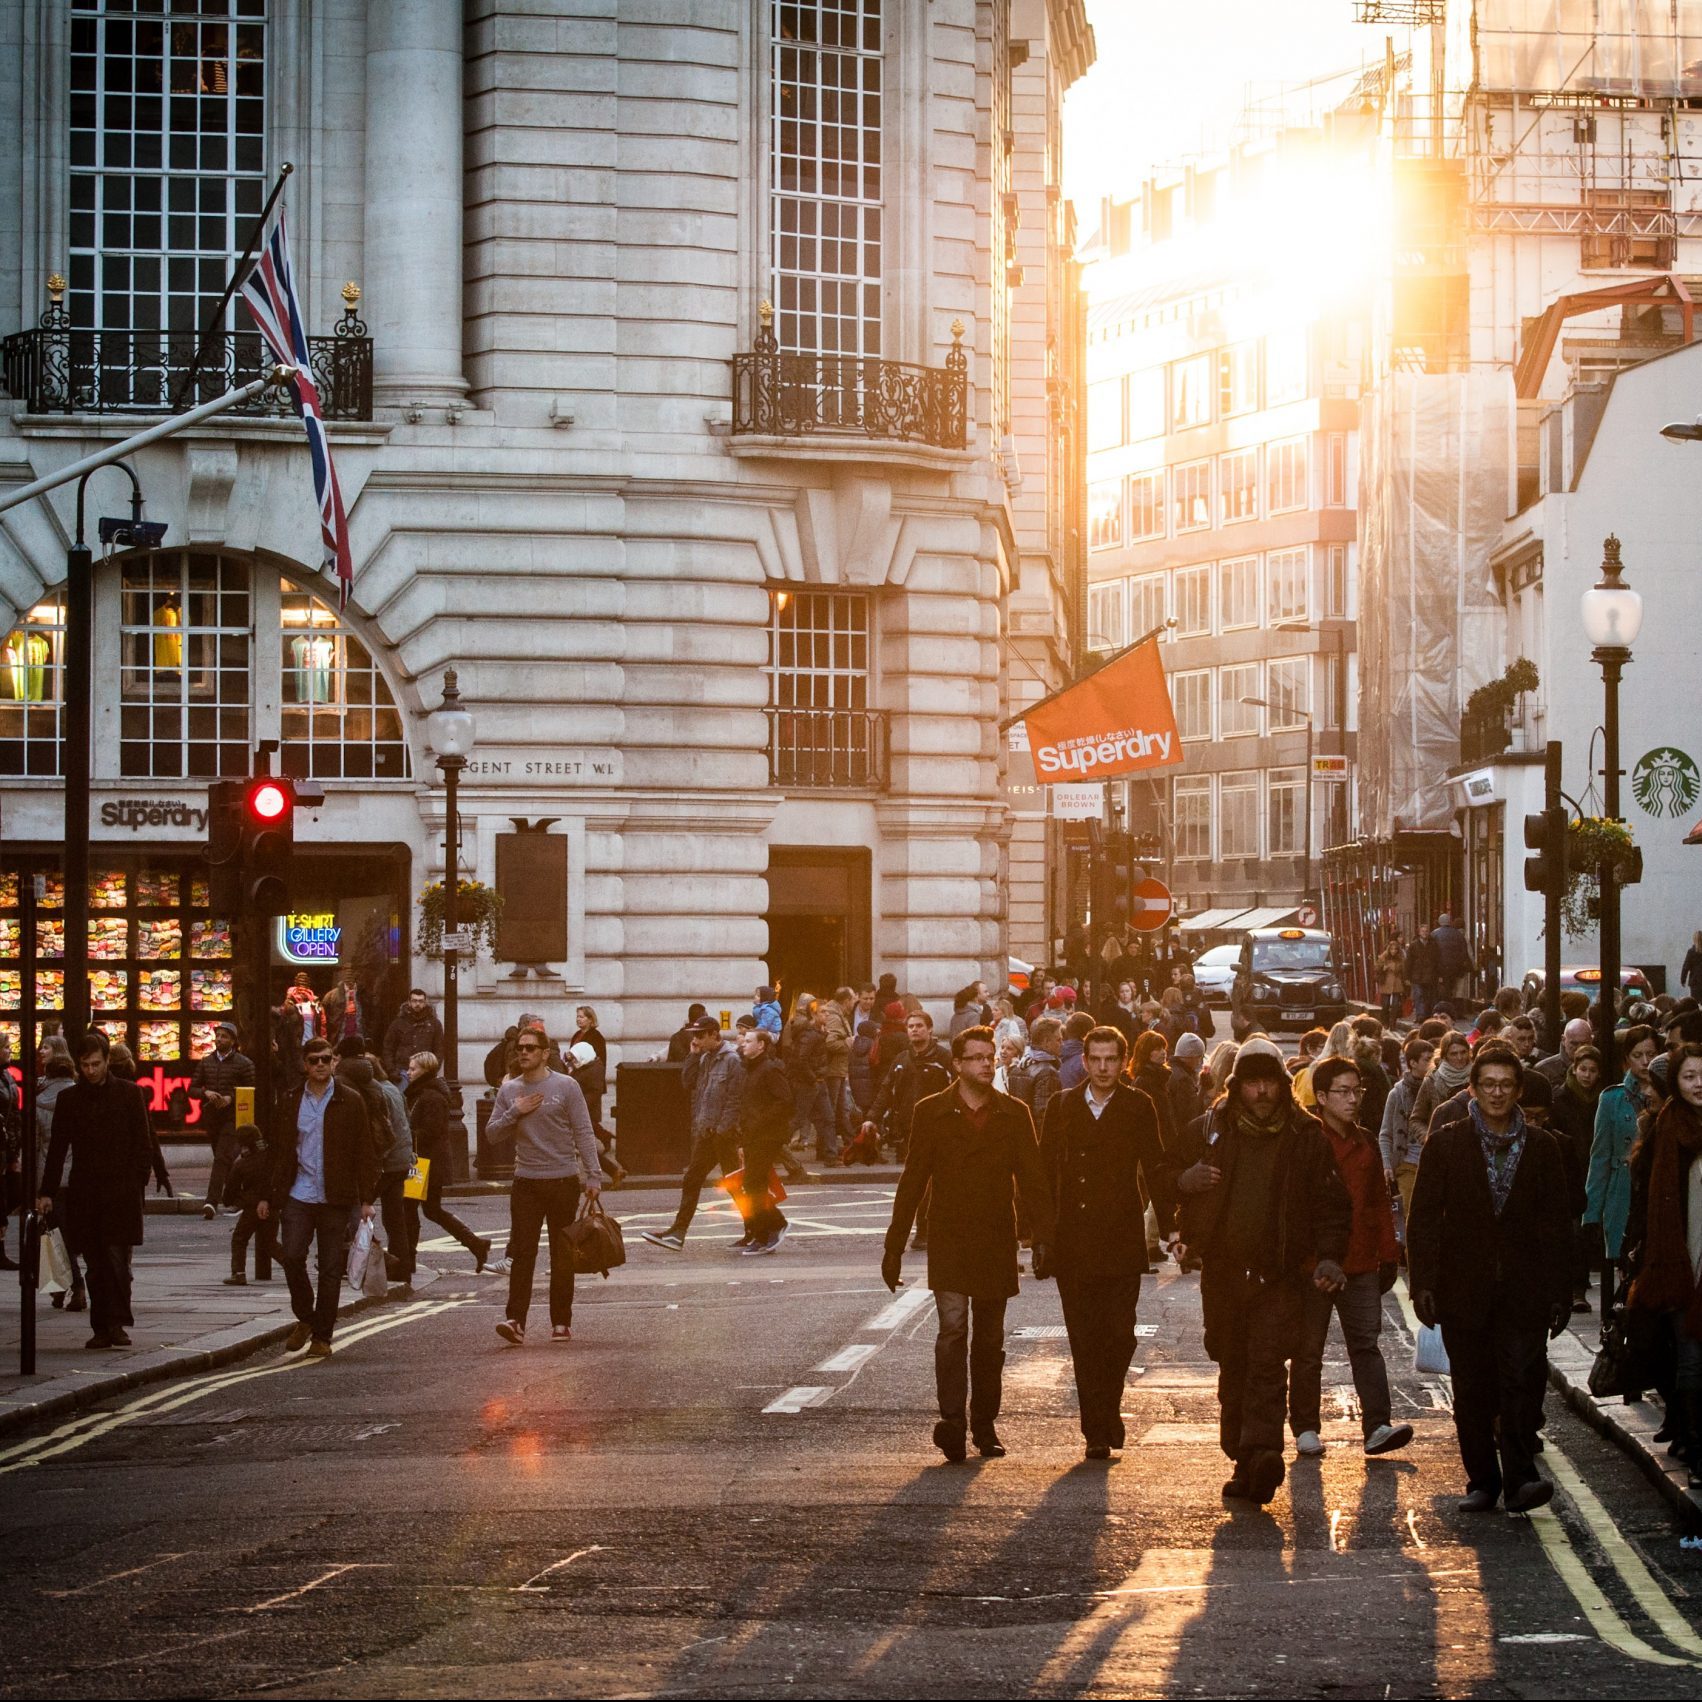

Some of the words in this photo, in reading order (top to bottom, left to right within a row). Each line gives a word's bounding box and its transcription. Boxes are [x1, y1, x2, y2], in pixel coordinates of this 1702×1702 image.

[1037, 730, 1171, 774] Superdry
[461, 761, 512, 774] GENT
[525, 762, 582, 774] STREET
[1056, 793, 1100, 801] ORLEBAR
[101, 801, 209, 832] Superdry
[287, 914, 335, 929] T-SHIRT
[290, 927, 342, 942] GALLERY
